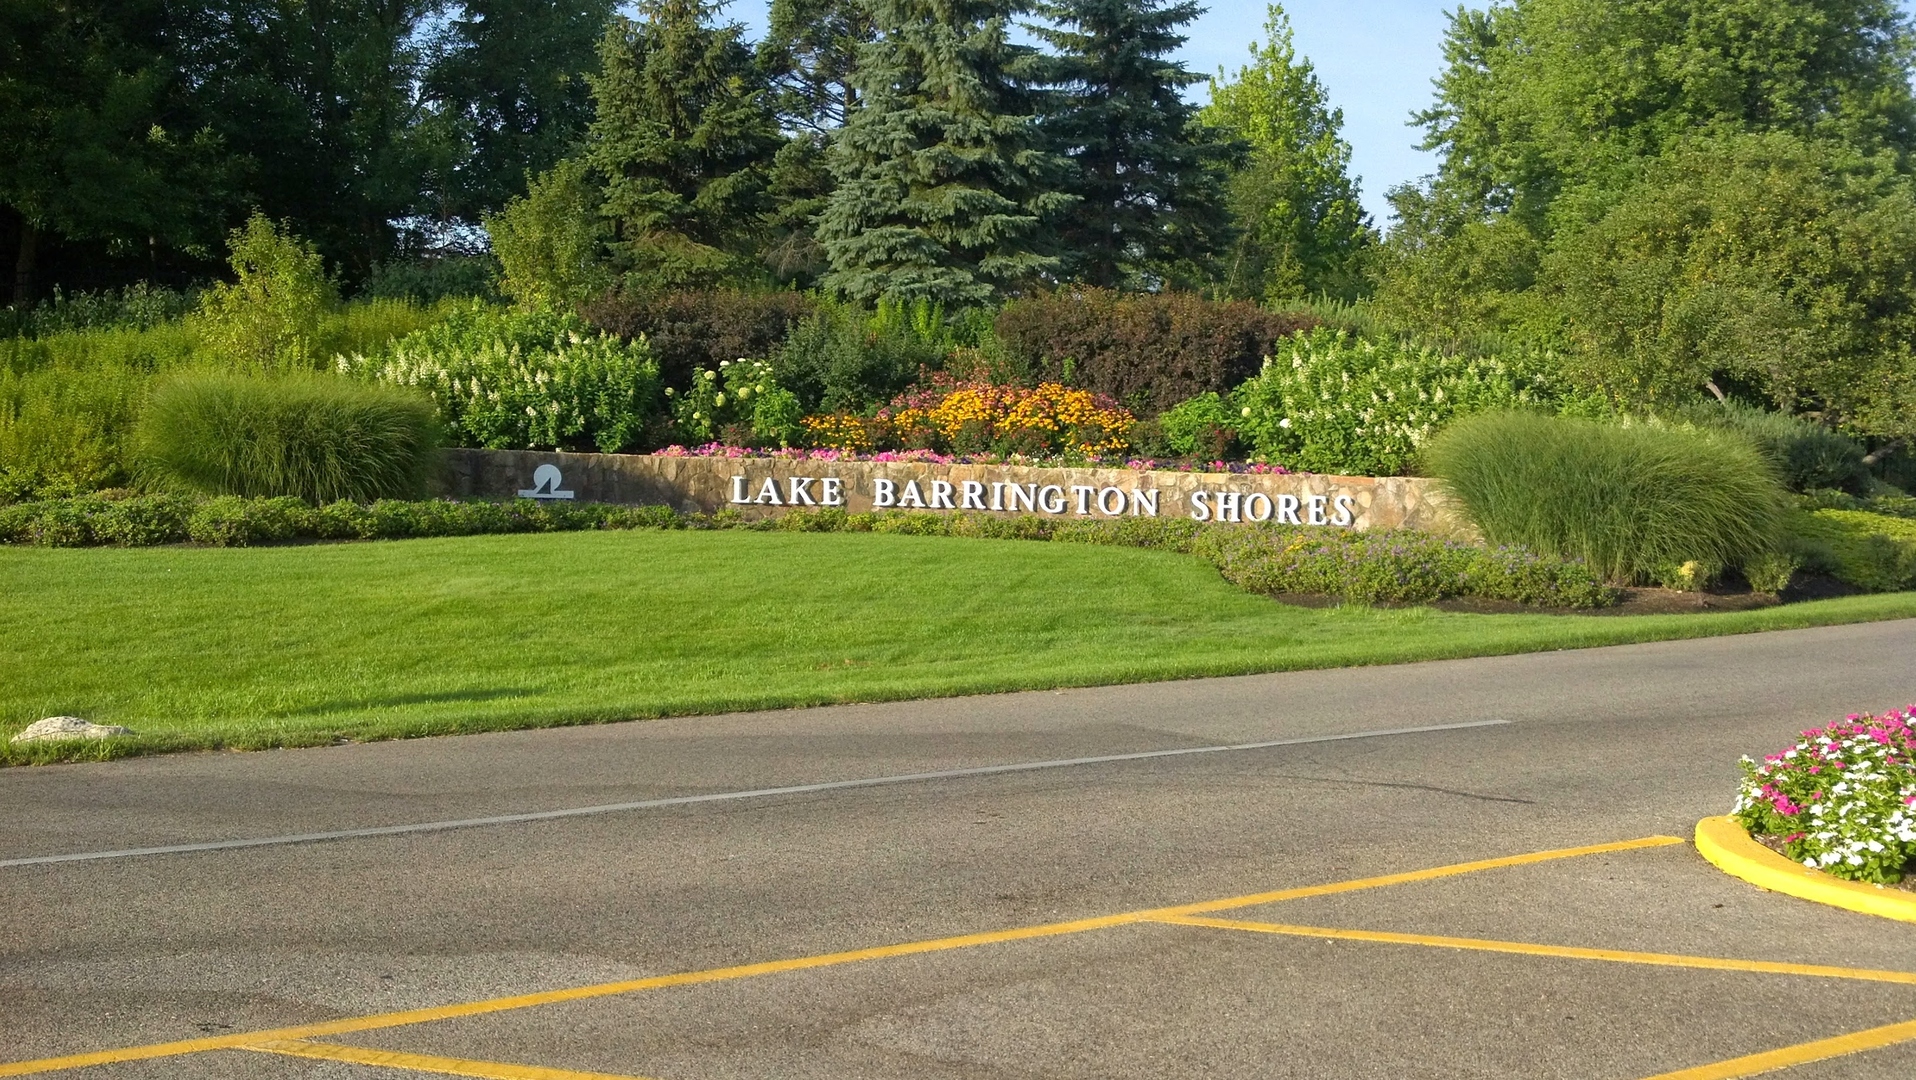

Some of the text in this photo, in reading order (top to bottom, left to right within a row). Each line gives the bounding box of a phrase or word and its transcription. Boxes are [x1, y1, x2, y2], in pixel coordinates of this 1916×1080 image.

[730, 475, 1355, 527] LAKE BARRINGTON SHORES
